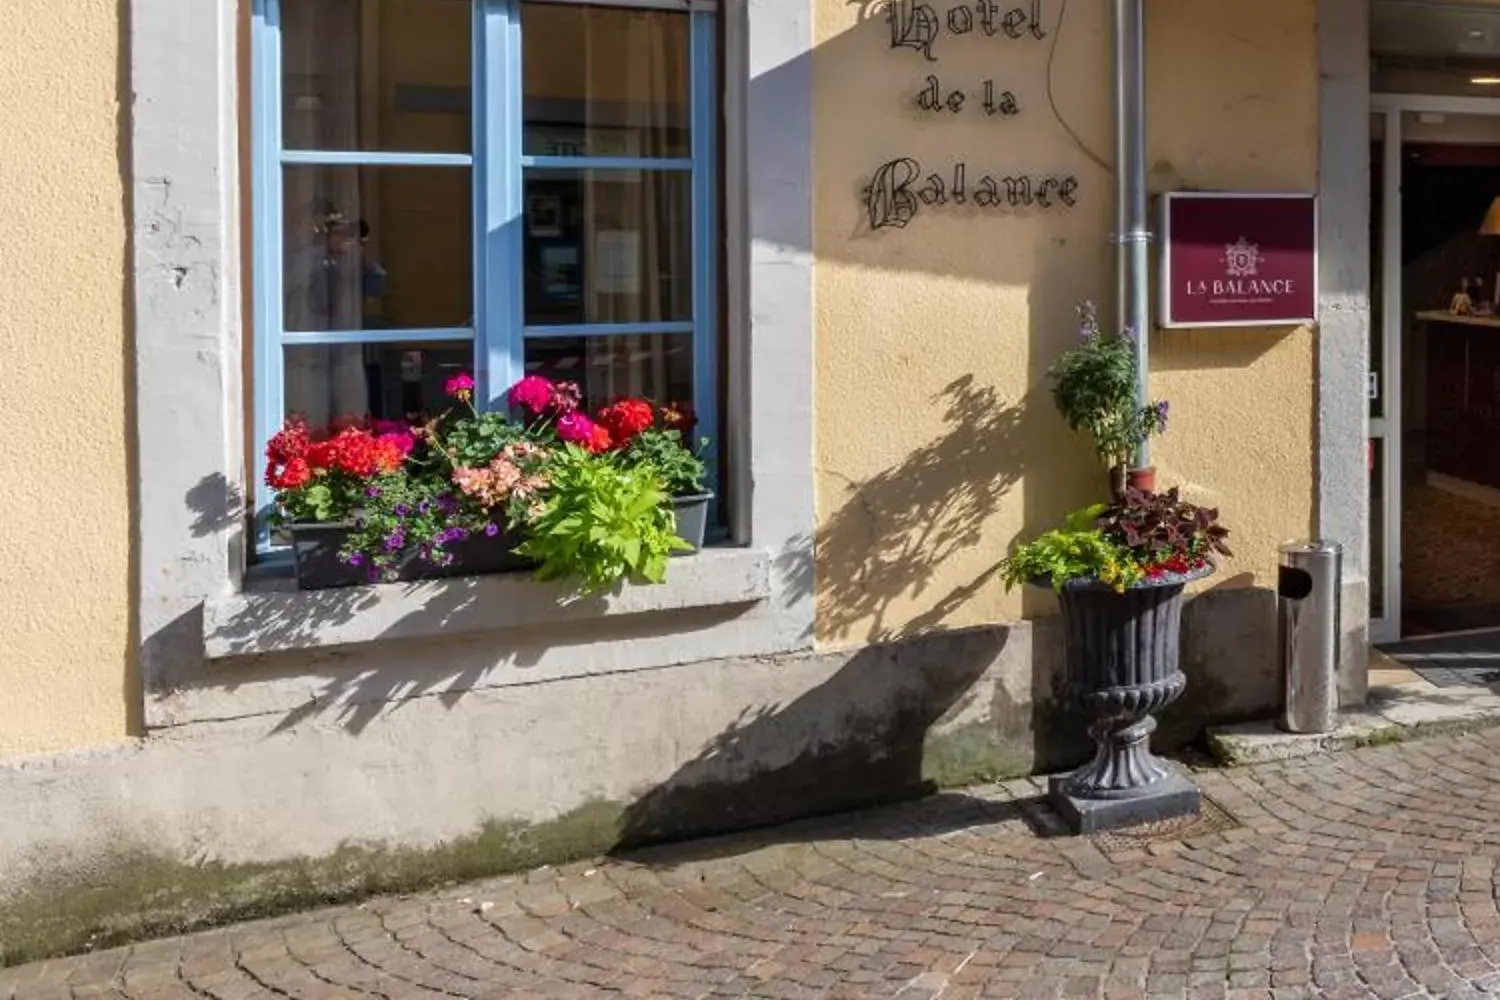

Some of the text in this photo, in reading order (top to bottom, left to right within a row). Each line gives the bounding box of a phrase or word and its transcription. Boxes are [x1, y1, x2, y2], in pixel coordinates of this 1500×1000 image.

[916, 74, 1020, 116] de la
[861, 156, 1079, 231] Balance
[1185, 278, 1296, 295] LA BALANCE
